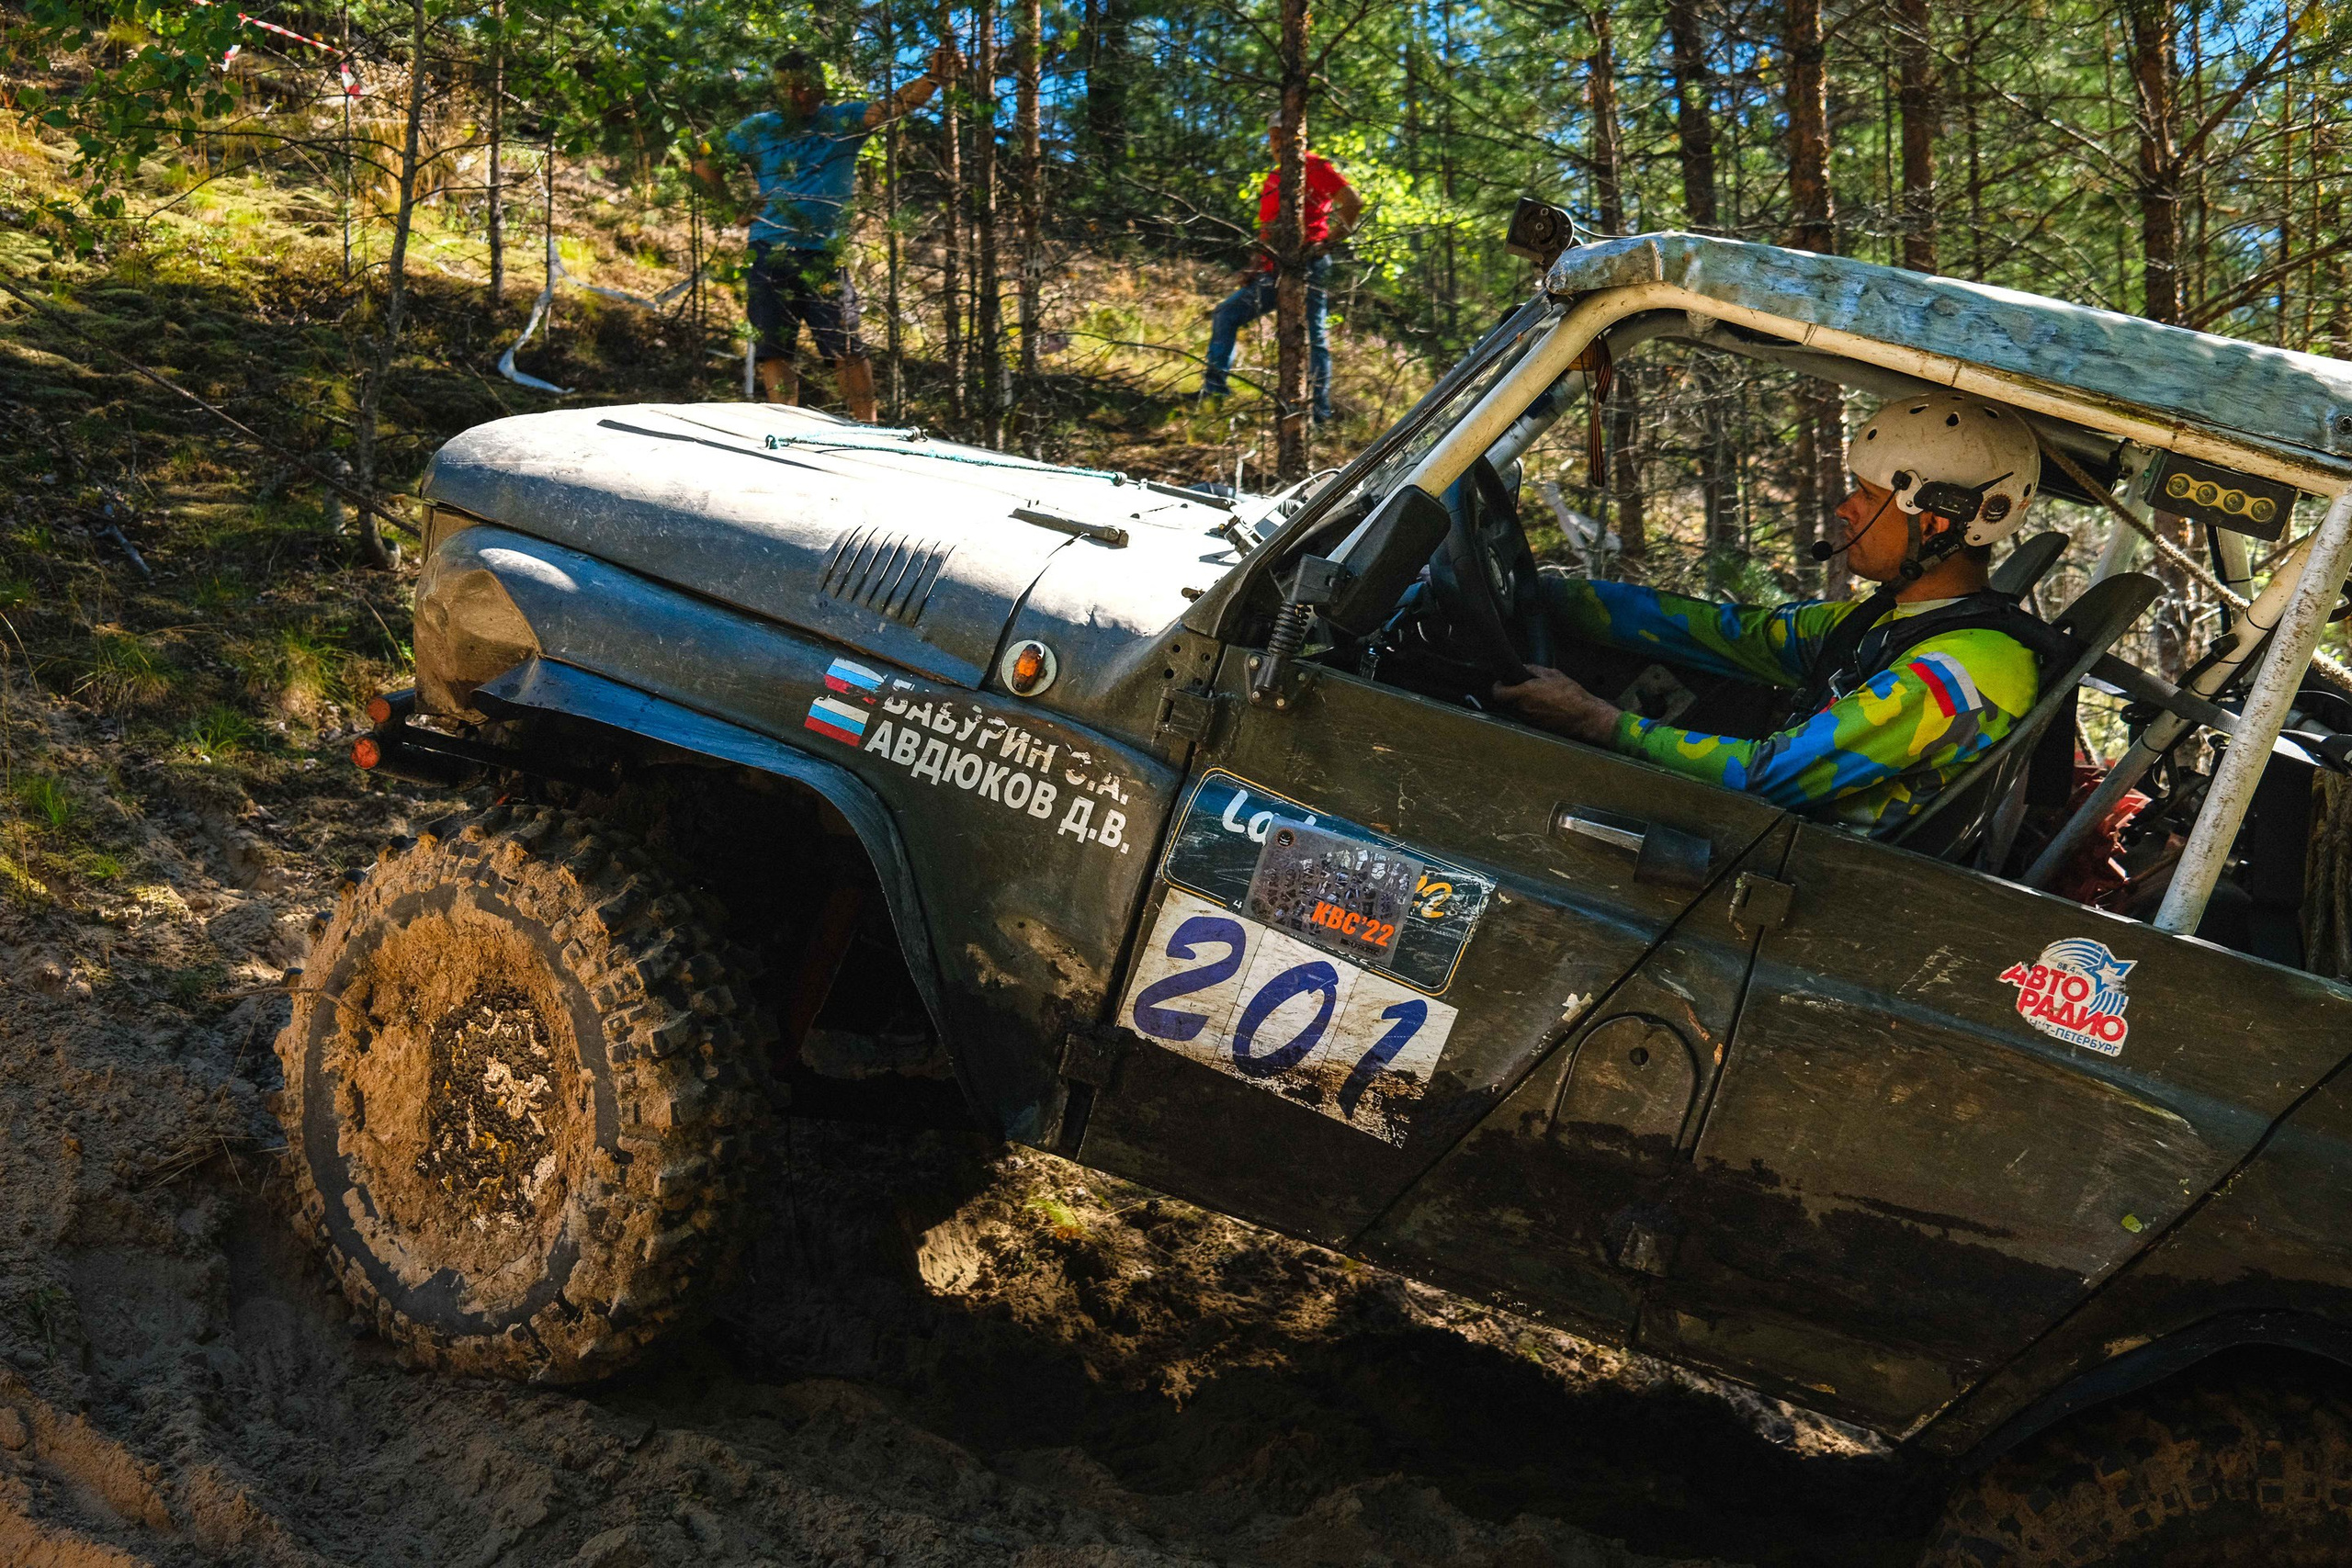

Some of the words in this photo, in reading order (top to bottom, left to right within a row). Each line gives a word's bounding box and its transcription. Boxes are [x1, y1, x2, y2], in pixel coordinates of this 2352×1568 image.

[864, 720, 1057, 819] АВДЮКОВ
[1057, 795, 1130, 854] Д.В.
[1133, 916, 1429, 1121] 201
[2000, 964, 2090, 1003] АВТО
[2018, 987, 2125, 1042] РАДИО
